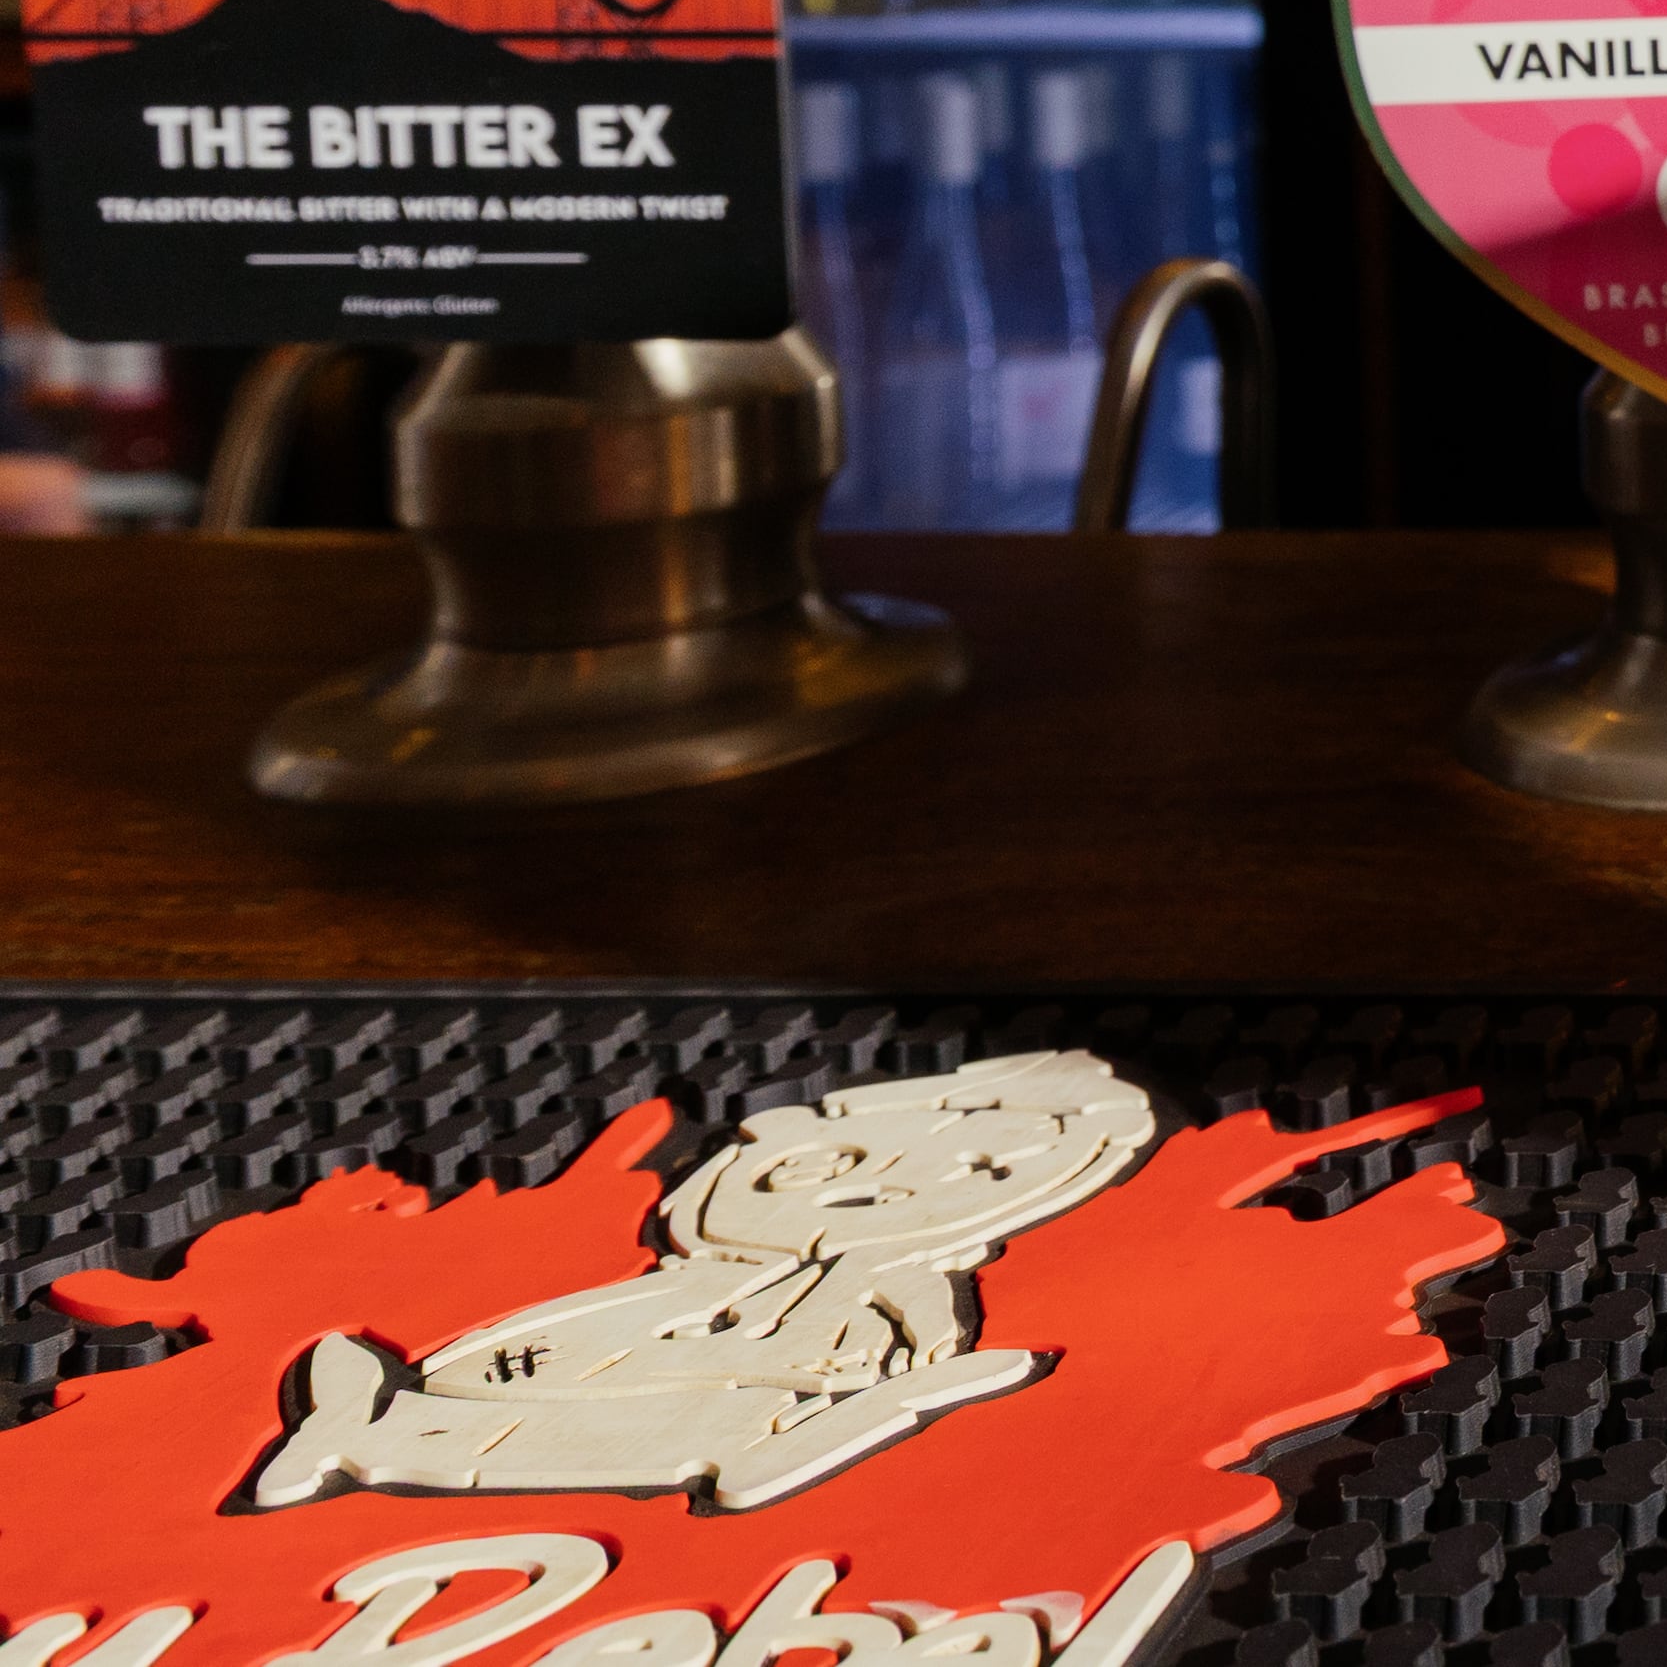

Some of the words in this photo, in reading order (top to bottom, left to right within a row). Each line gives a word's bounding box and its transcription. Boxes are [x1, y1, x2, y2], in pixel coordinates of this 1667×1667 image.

[144, 106, 294, 170] THE
[309, 105, 562, 170] BITTER
[577, 105, 676, 169] EX
[98, 196, 297, 223] TRADITIONAL
[298, 196, 400, 223] BITTER
[402, 196, 478, 222] WITH
[481, 196, 509, 222] A
[510, 196, 637, 222] MODERN
[639, 195, 730, 221] TWIST
